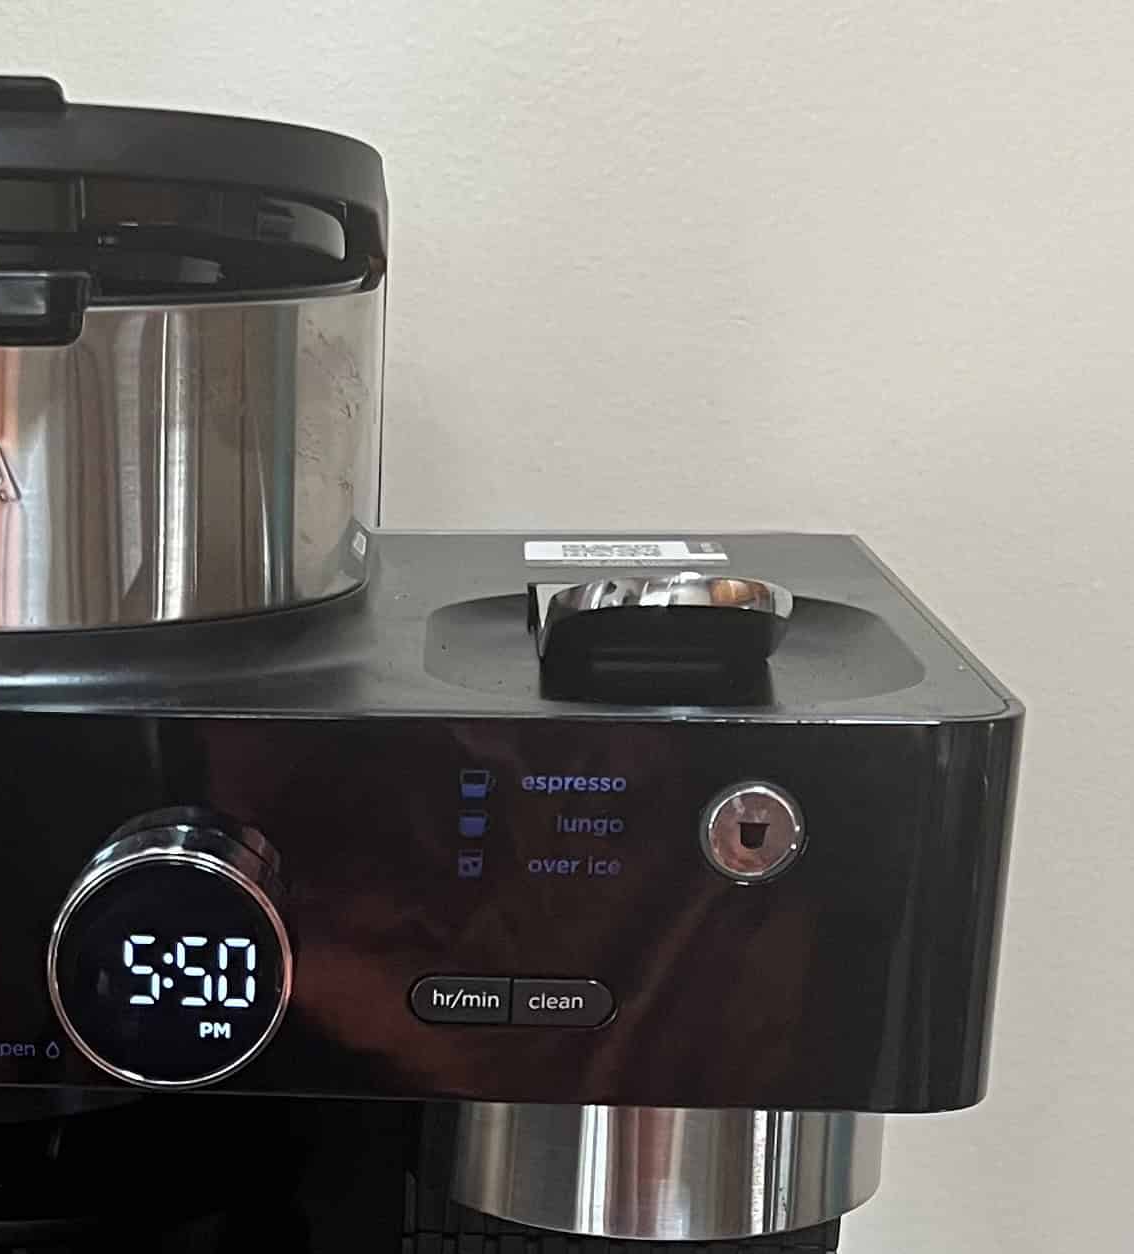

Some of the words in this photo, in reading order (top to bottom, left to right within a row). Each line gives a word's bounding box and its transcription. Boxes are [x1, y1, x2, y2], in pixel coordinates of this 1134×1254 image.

[521, 775, 628, 795] espresso
[556, 814, 625, 837] lungo
[528, 858, 581, 875] over
[587, 855, 622, 877] ice
[123, 934, 257, 1008] 5:50
[433, 988, 501, 1010] hr/min
[528, 992, 584, 1010] clean
[199, 1021, 232, 1039] PM
